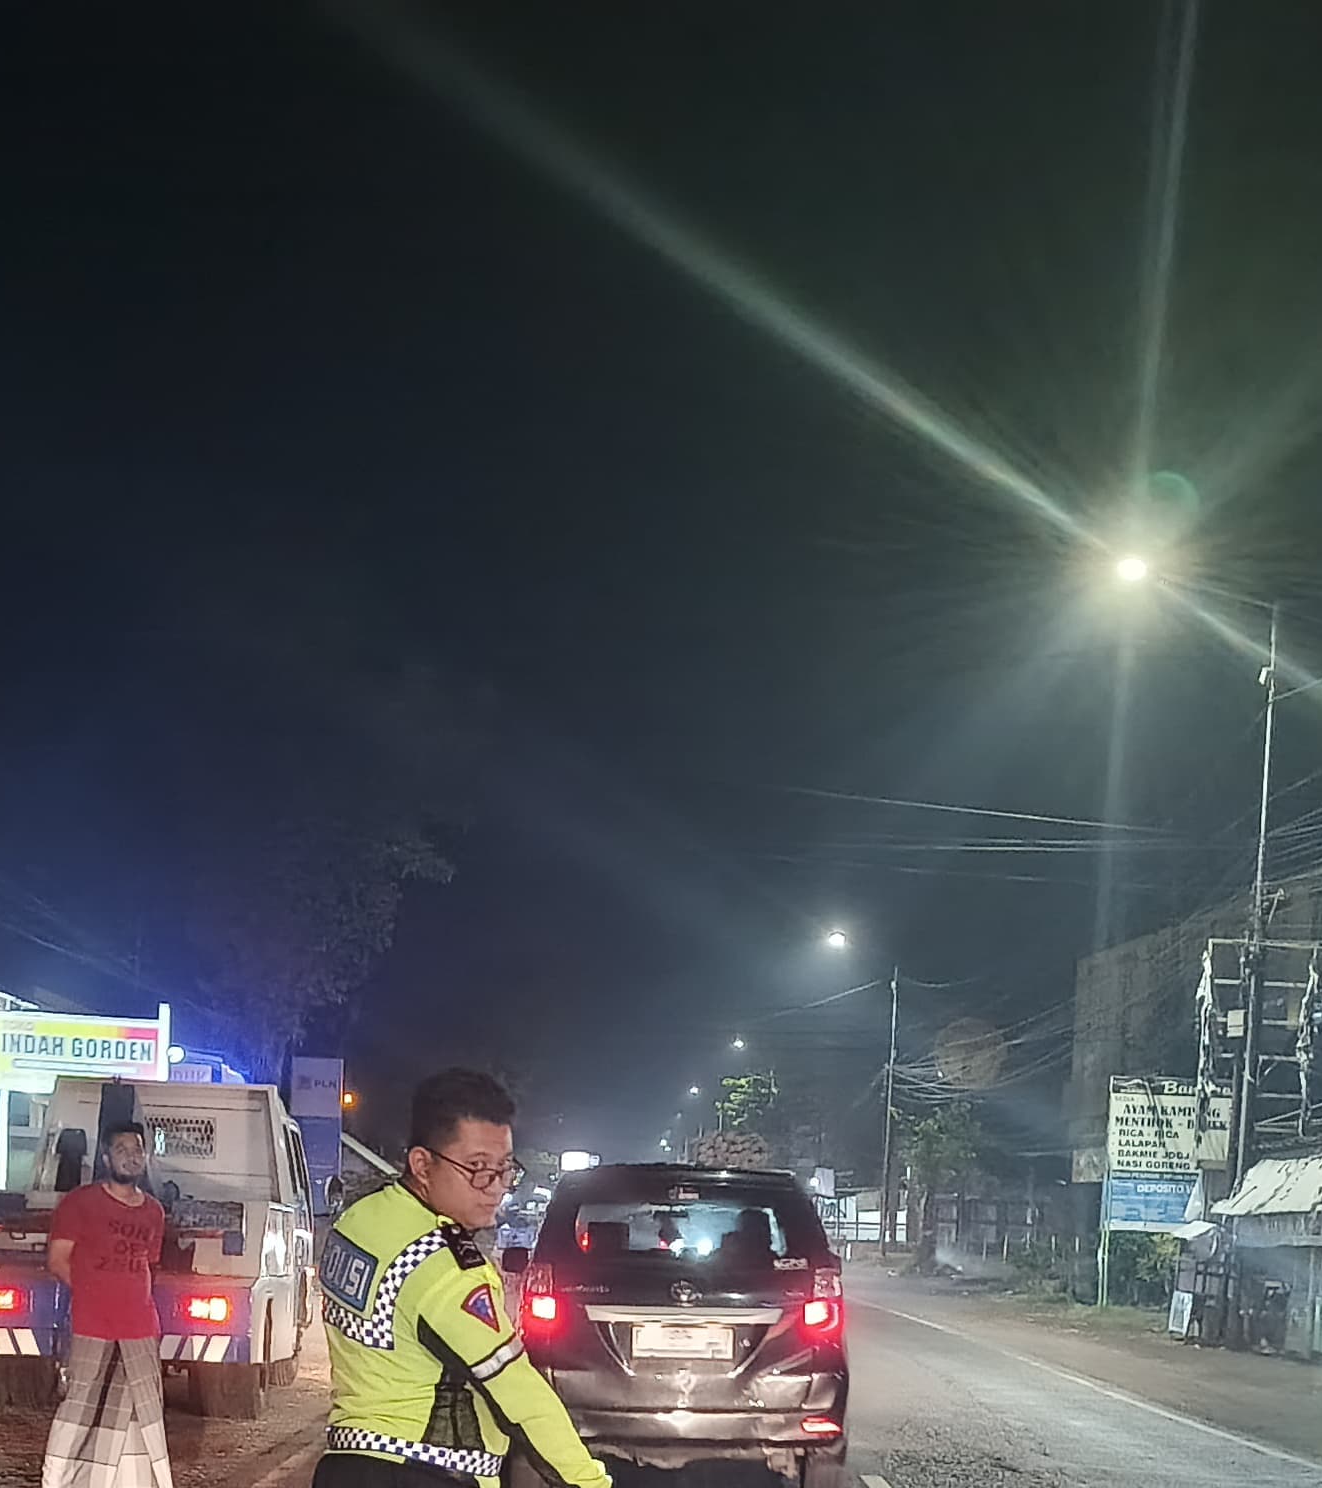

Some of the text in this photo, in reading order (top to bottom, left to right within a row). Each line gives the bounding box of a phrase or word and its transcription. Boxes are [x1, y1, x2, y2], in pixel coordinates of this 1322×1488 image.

[1, 1032, 154, 1062] INDAH GORDEN
[313, 1079, 338, 1090] PLN
[1123, 1103, 1157, 1117] AYAM
[1118, 1138, 1166, 1149] LALAPAN
[1117, 1159, 1191, 1170] NASI GORENG
[1136, 1183, 1186, 1194] DEPOSITO
